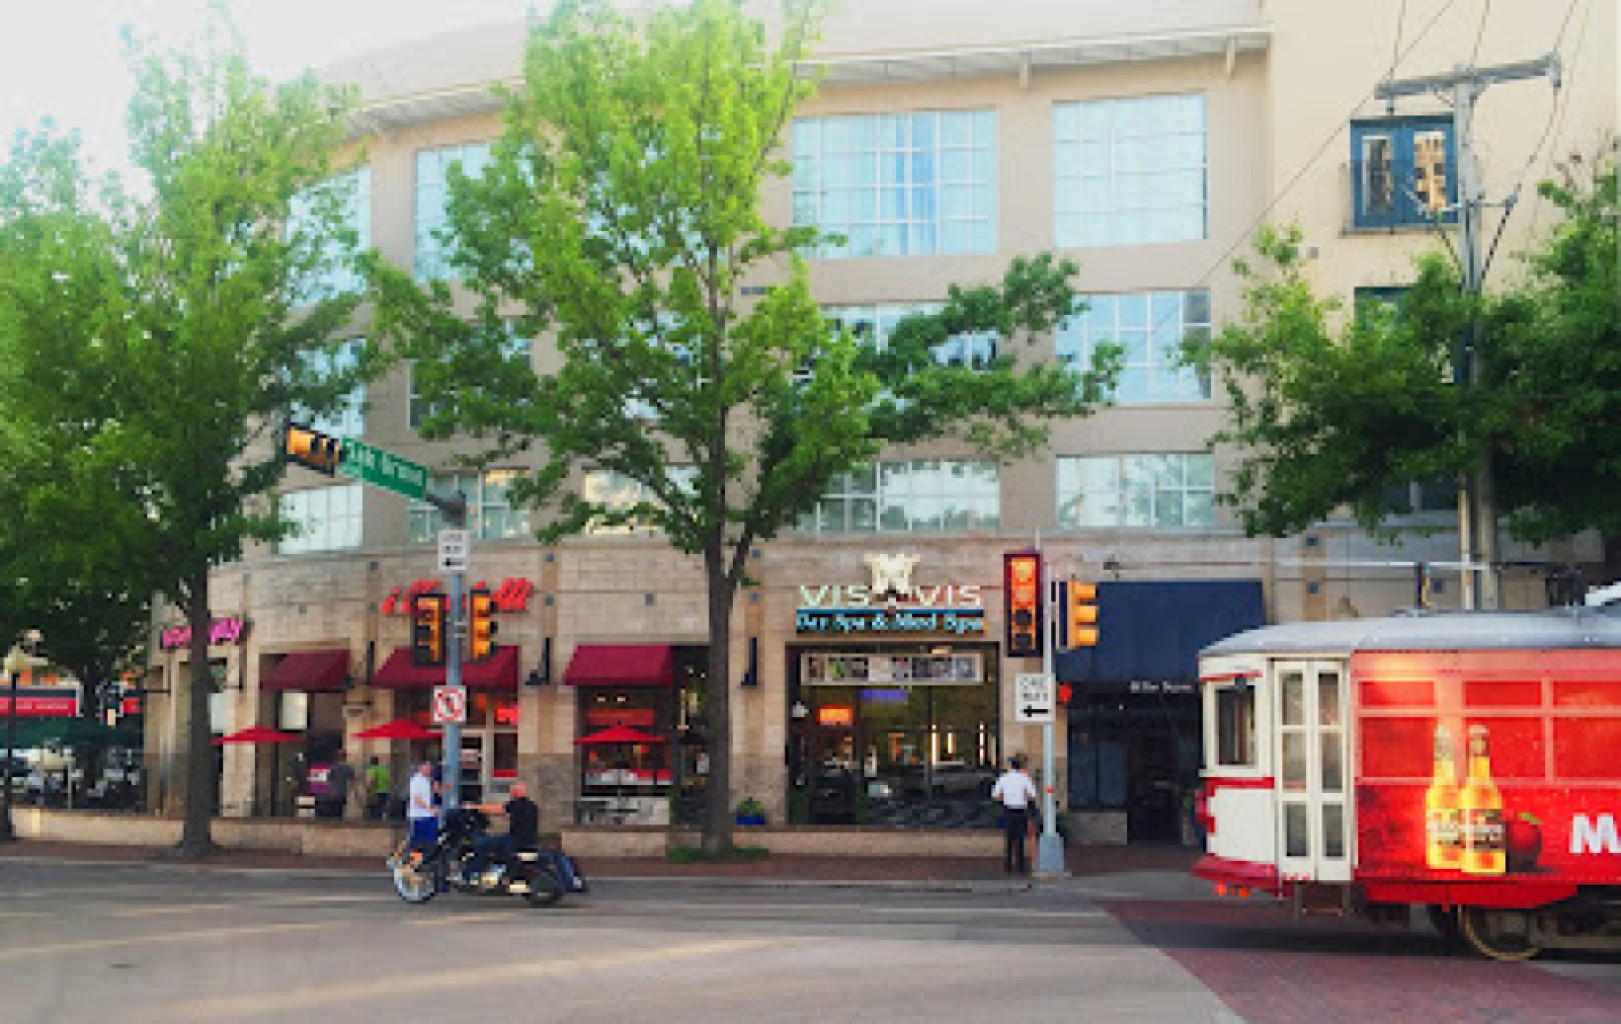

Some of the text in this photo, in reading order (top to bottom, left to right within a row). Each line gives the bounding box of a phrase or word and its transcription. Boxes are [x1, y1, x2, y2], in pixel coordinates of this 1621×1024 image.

[800, 584, 982, 607] VIS VIS
[832, 613, 866, 633] Spa
[871, 613, 889, 631] &
[943, 613, 985, 635] Spa
